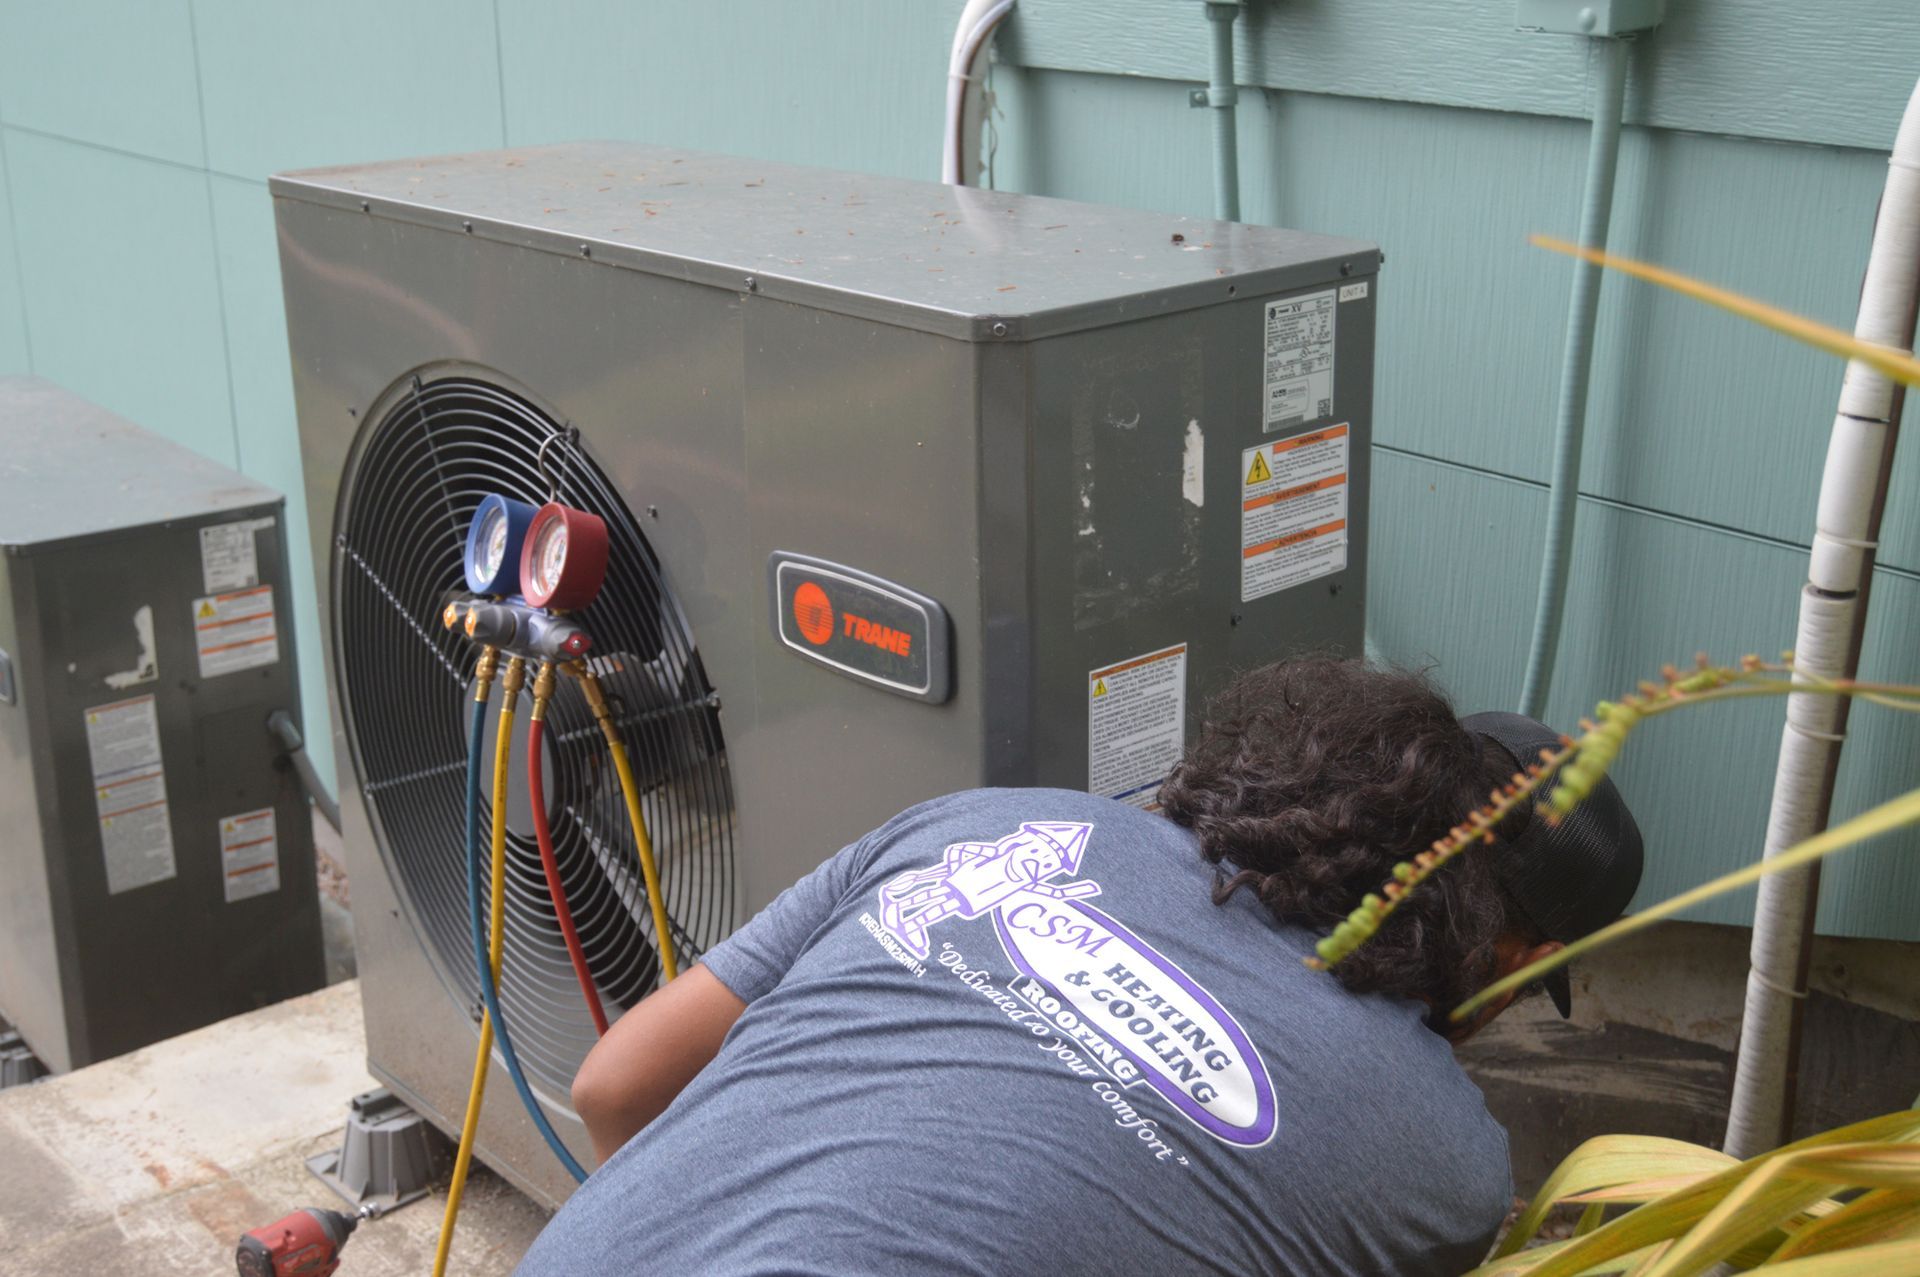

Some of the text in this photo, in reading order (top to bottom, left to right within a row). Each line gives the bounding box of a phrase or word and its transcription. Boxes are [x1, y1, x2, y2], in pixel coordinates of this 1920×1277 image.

[842, 612, 912, 657] TRANE
[1006, 902, 1115, 958] CSM
[1021, 978, 1139, 1080] ROOFING
[1024, 1018, 1050, 1036] to
[1038, 1038, 1098, 1077] your
[1064, 970, 1219, 1104] & COOLING
[1103, 962, 1232, 1071] HEATING
